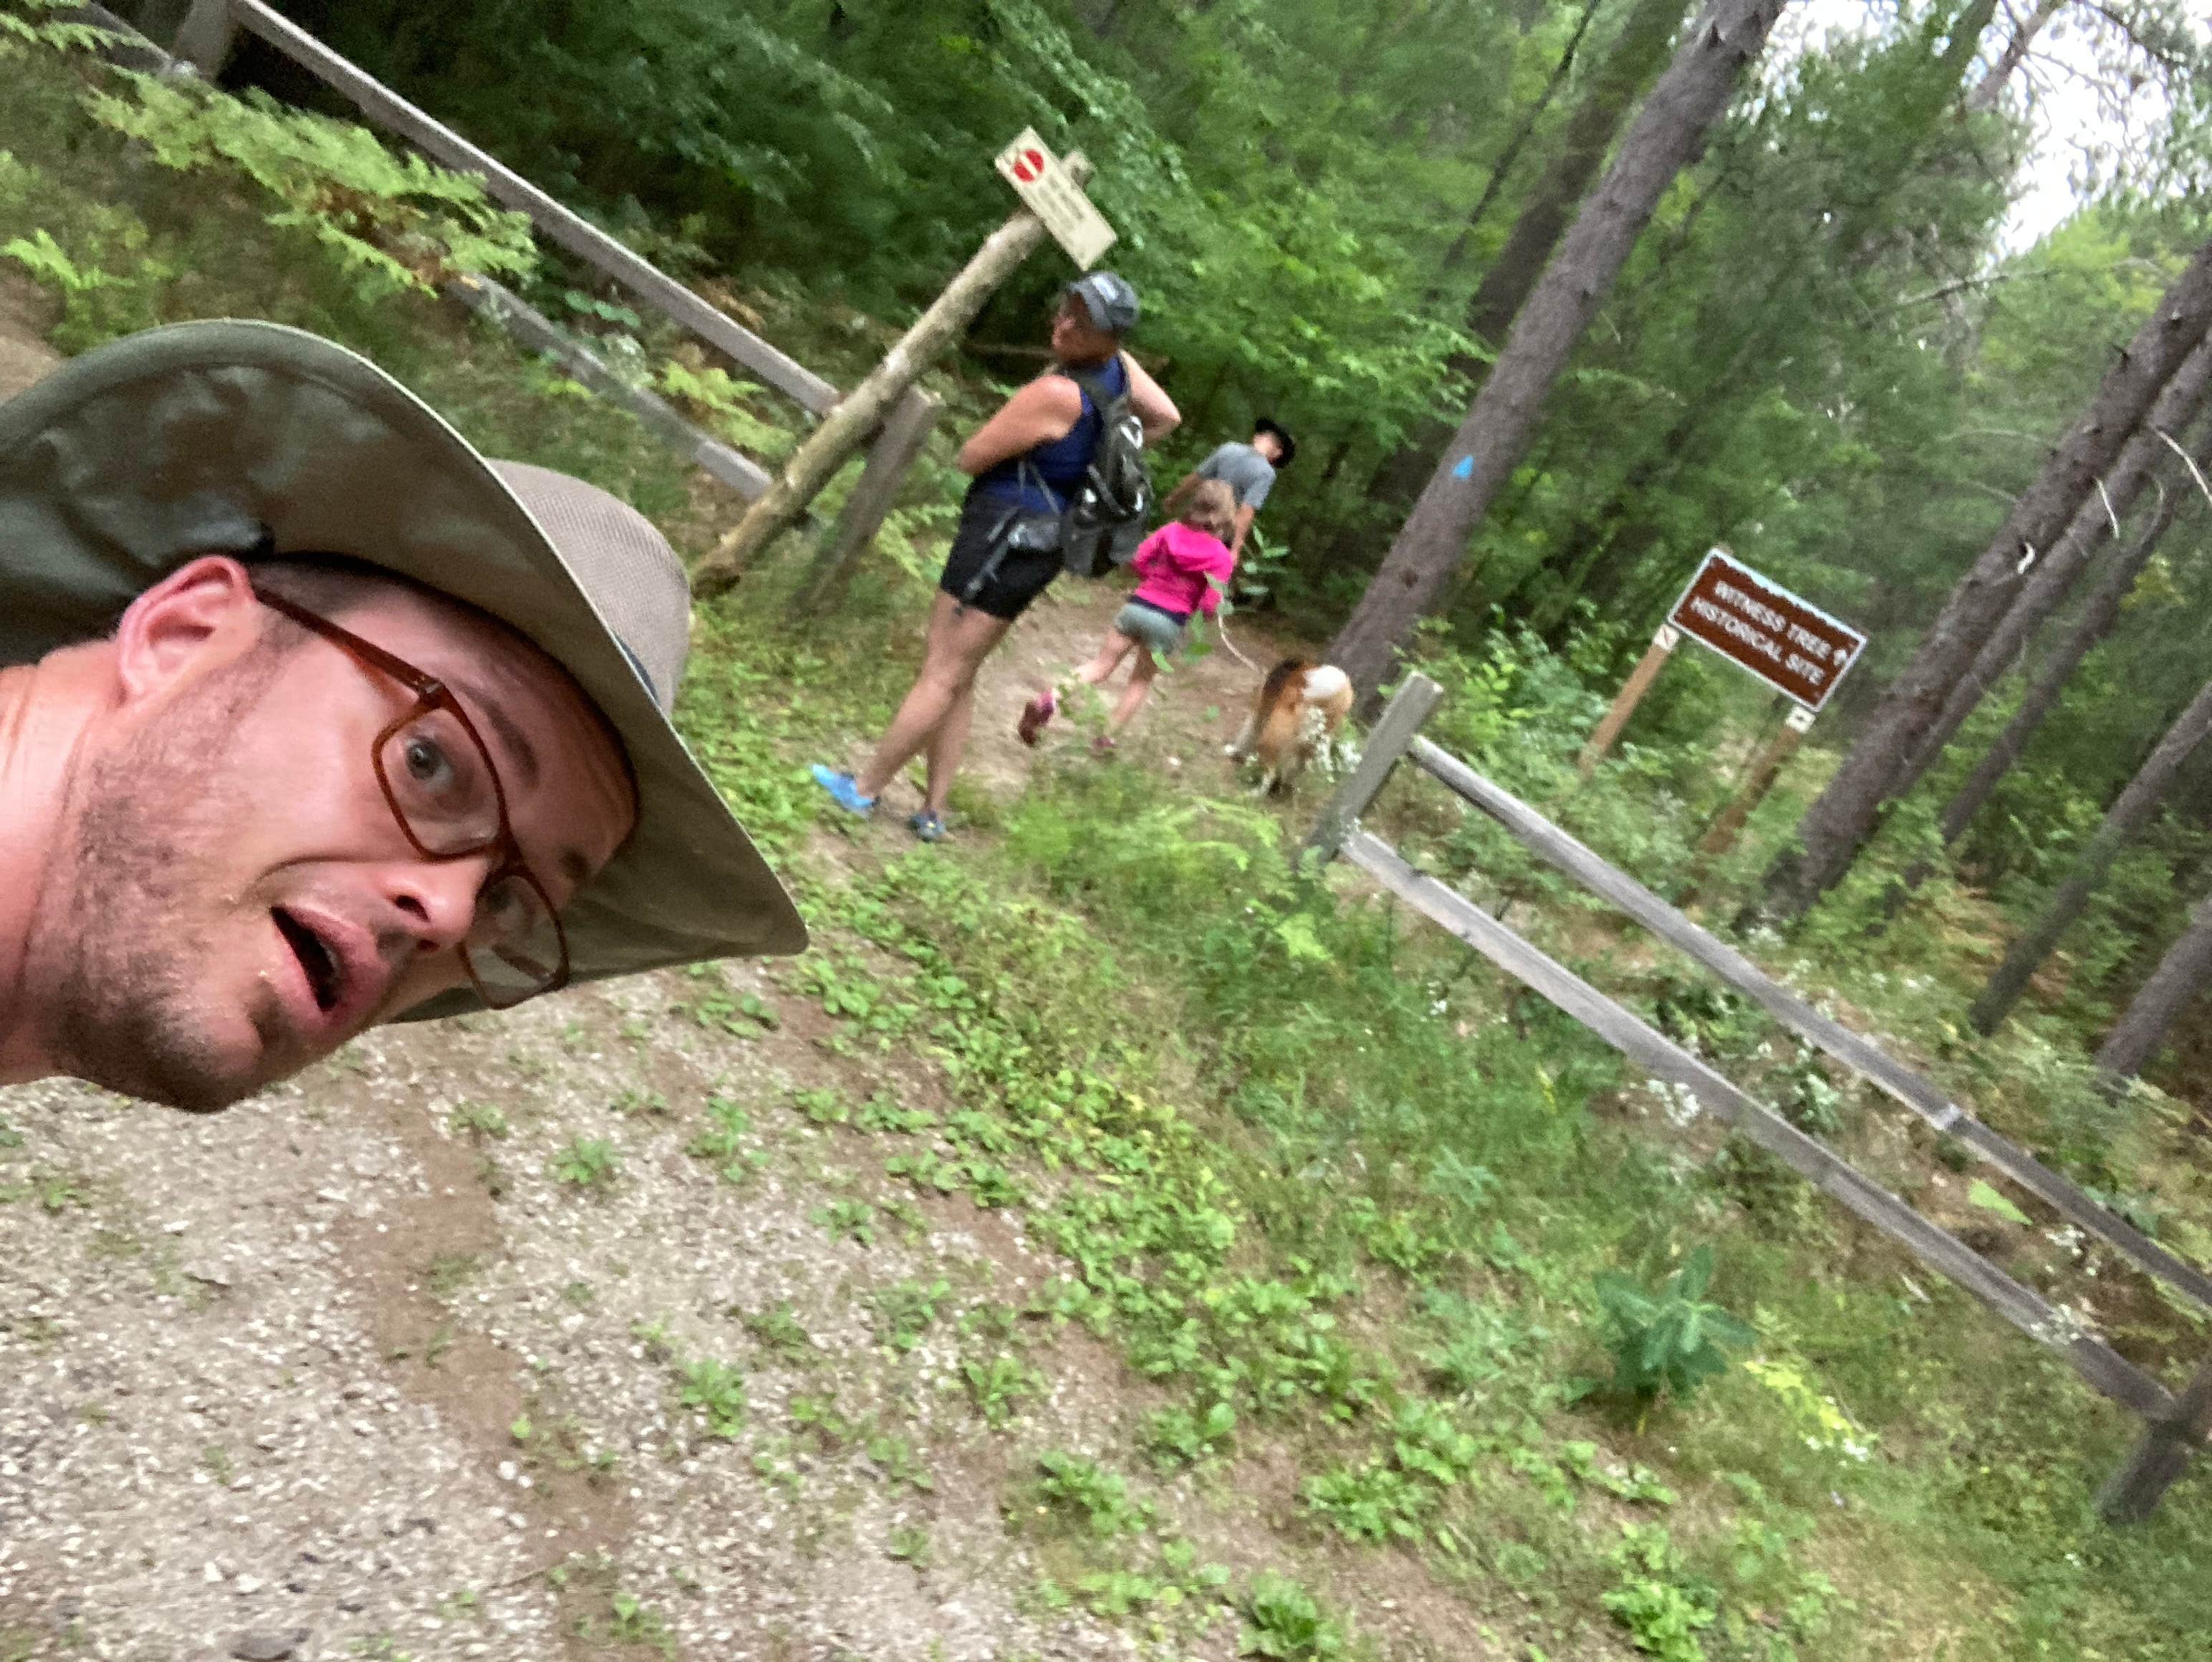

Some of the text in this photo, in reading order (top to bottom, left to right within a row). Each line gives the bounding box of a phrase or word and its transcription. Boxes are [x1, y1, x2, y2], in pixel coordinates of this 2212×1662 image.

[1691, 596, 1825, 686] HISTORICAL SITE
[1715, 580, 1832, 659] WITNESS TREE
